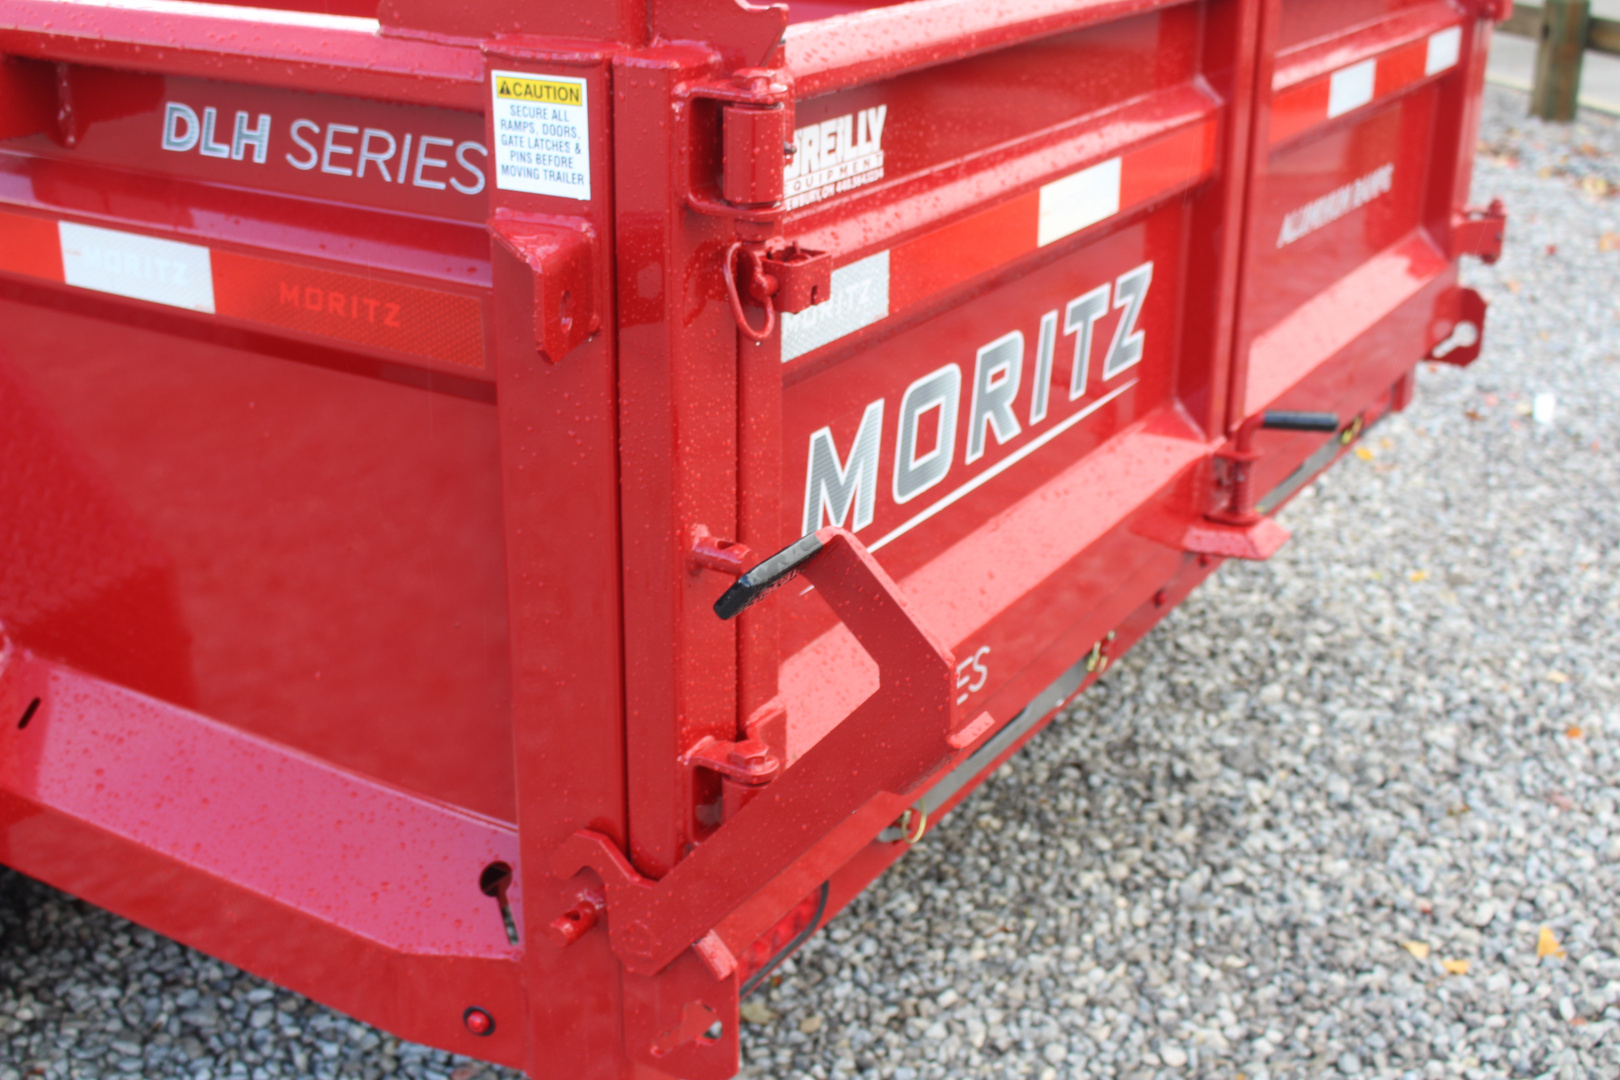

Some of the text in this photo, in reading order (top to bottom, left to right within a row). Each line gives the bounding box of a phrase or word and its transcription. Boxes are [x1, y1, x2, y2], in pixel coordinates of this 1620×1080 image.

[512, 81, 580, 103] CAUTION
[510, 104, 570, 122] SECURE ALL
[500, 119, 581, 140] RAMPS, DOORS,
[160, 101, 489, 195] DLH SERIES
[501, 134, 581, 154] GATE LATCHES &
[510, 150, 574, 169] PINS BEFORE
[501, 164, 585, 185] MOVING TRAILER
[278, 281, 401, 328] MORITZ
[802, 261, 1154, 537] MORITZ
